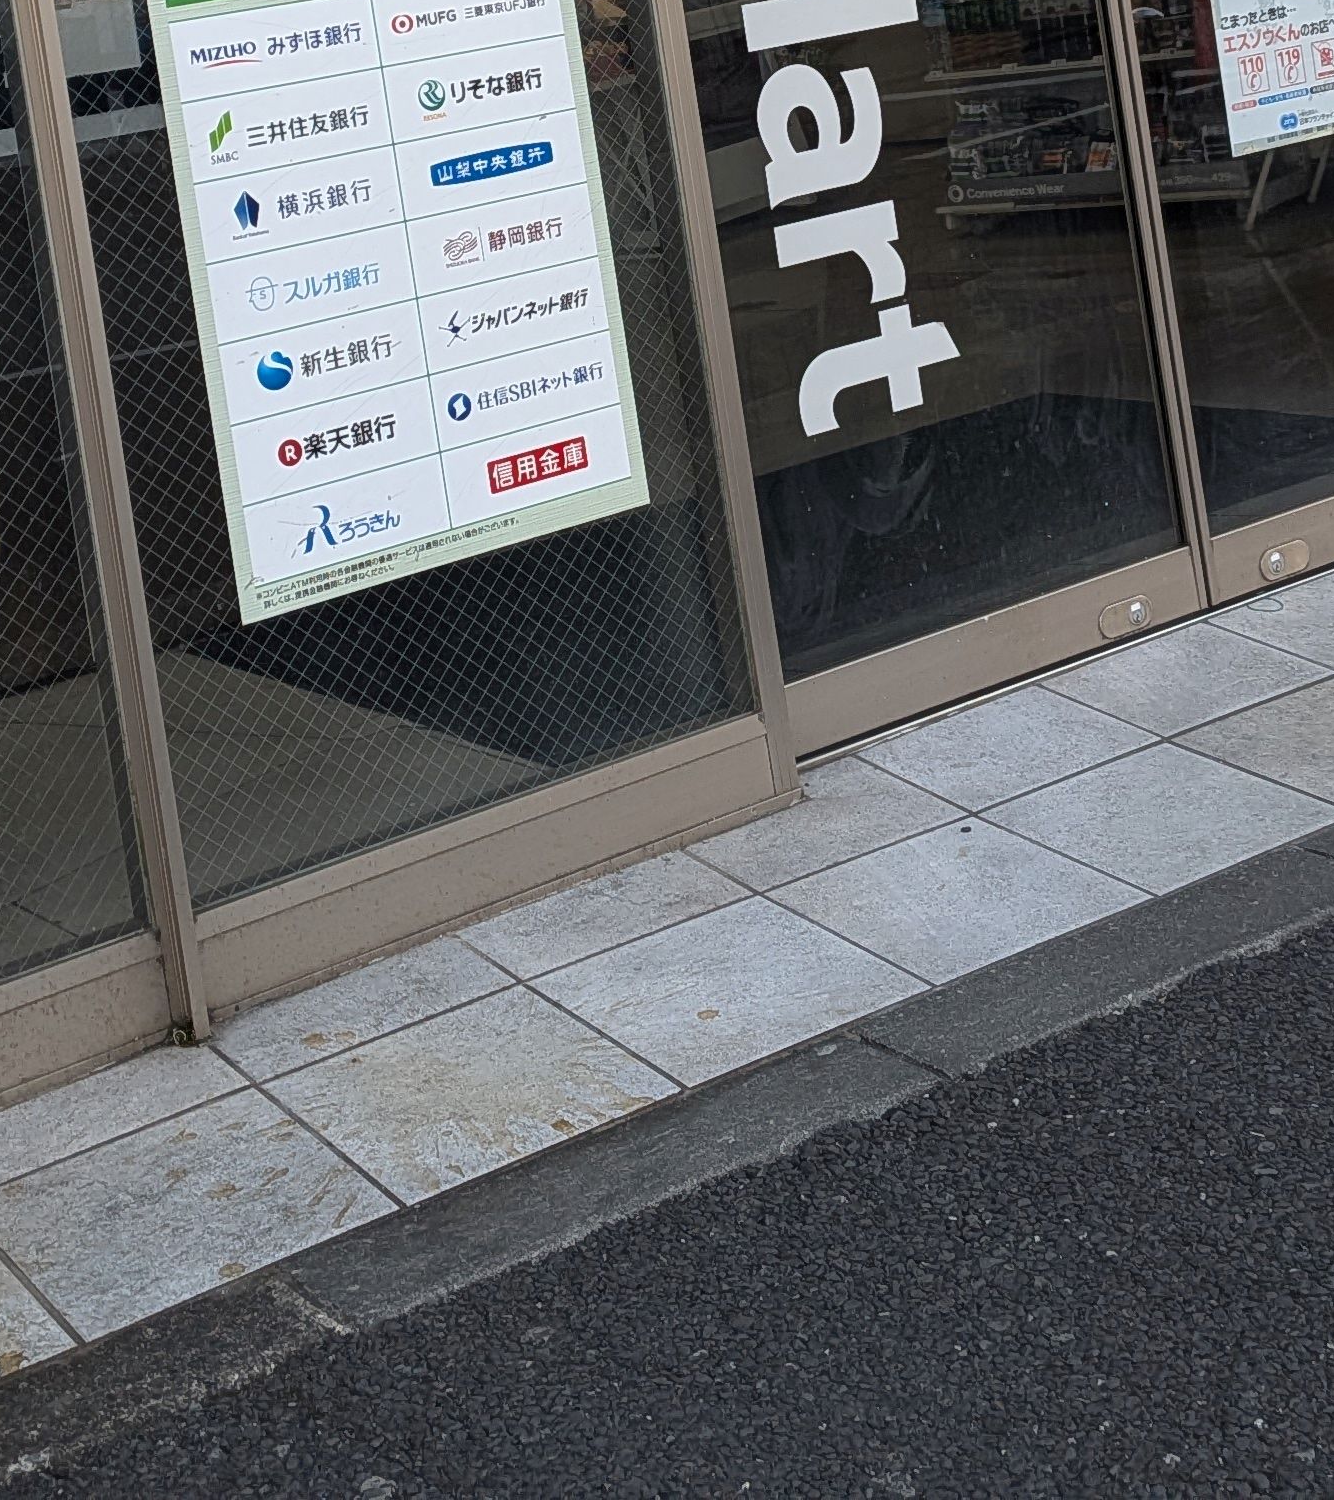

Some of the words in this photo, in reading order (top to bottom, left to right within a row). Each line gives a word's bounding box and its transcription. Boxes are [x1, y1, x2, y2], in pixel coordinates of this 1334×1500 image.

[415, 8, 458, 29] MUFG
[189, 40, 258, 66] MIZUHO
[266, 21, 363, 58] みずほ銀行
[1276, 48, 1301, 69] 119
[450, 66, 543, 104] りそな銀行
[1239, 57, 1265, 76] 110
[245, 104, 370, 149] 三井住友銀行
[210, 150, 240, 166] SMBC
[436, 146, 546, 183] 山梨中央銀行
[276, 178, 372, 220] 横浜銀行
[966, 184, 1036, 200] Convenience
[1038, 182, 1065, 197] Wear
[487, 216, 563, 253] 静岡銀行
[282, 262, 380, 304] スルガ銀行
[471, 287, 589, 334] ジャパンネット銀行
[299, 332, 394, 378] 新生銀行
[477, 360, 604, 411] 住信SBIネット銀行
[302, 413, 397, 461] 楽天銀行
[491, 441, 585, 490] 信用金庫
[337, 508, 401, 544] ろうきん
